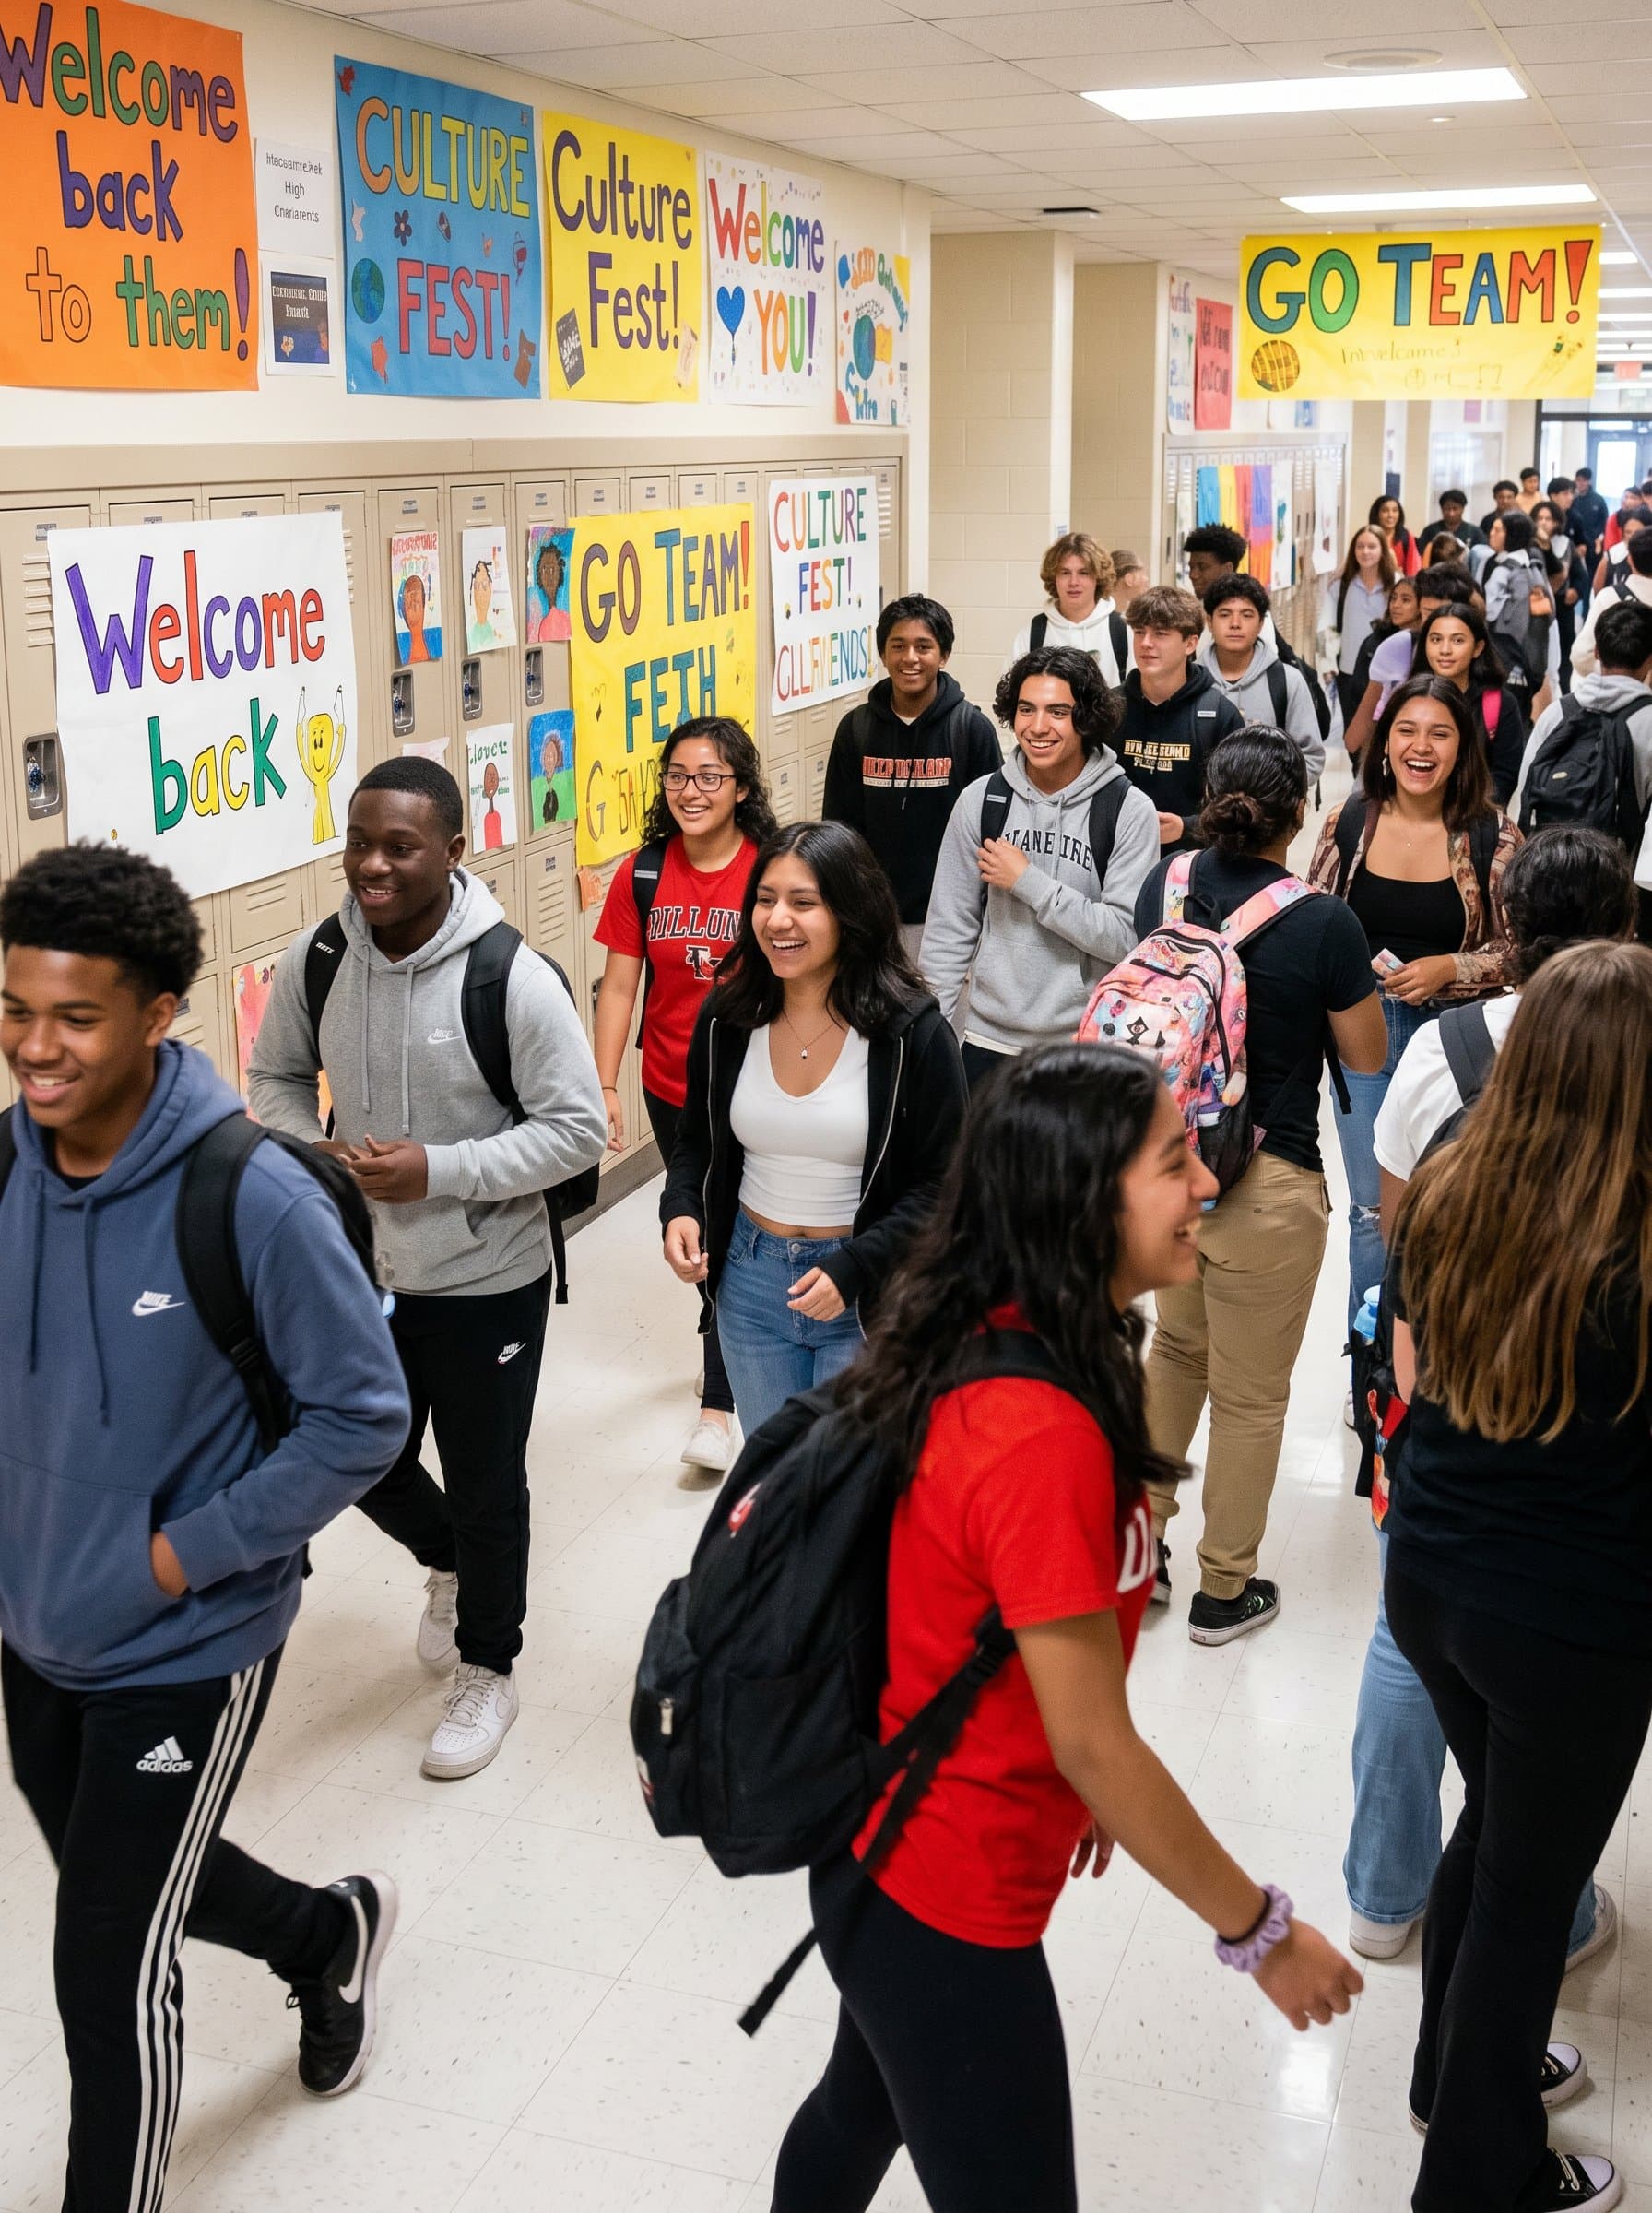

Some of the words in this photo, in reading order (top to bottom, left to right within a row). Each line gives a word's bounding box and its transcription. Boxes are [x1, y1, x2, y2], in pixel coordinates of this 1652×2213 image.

[0, 2, 238, 142] Welcome
[56, 130, 183, 242] back
[284, 181, 305, 200] High
[355, 96, 531, 218] CULTURE
[553, 129, 692, 250] Culture
[708, 177, 824, 274] Welcome
[26, 246, 91, 342] to
[116, 247, 251, 361] them!
[396, 257, 511, 362] FEST!
[587, 250, 680, 352] Fest!
[753, 288, 817, 377] YOU!
[1246, 245, 1360, 334] GO
[1377, 239, 1594, 326] TEAM!
[774, 487, 867, 553] CULTURE
[65, 550, 325, 694] Welcome
[580, 539, 642, 644] GO
[654, 520, 750, 627] TEAM!
[798, 555, 852, 615] FEST!
[148, 697, 287, 835] back
[136, 1759, 193, 1773] adidas
